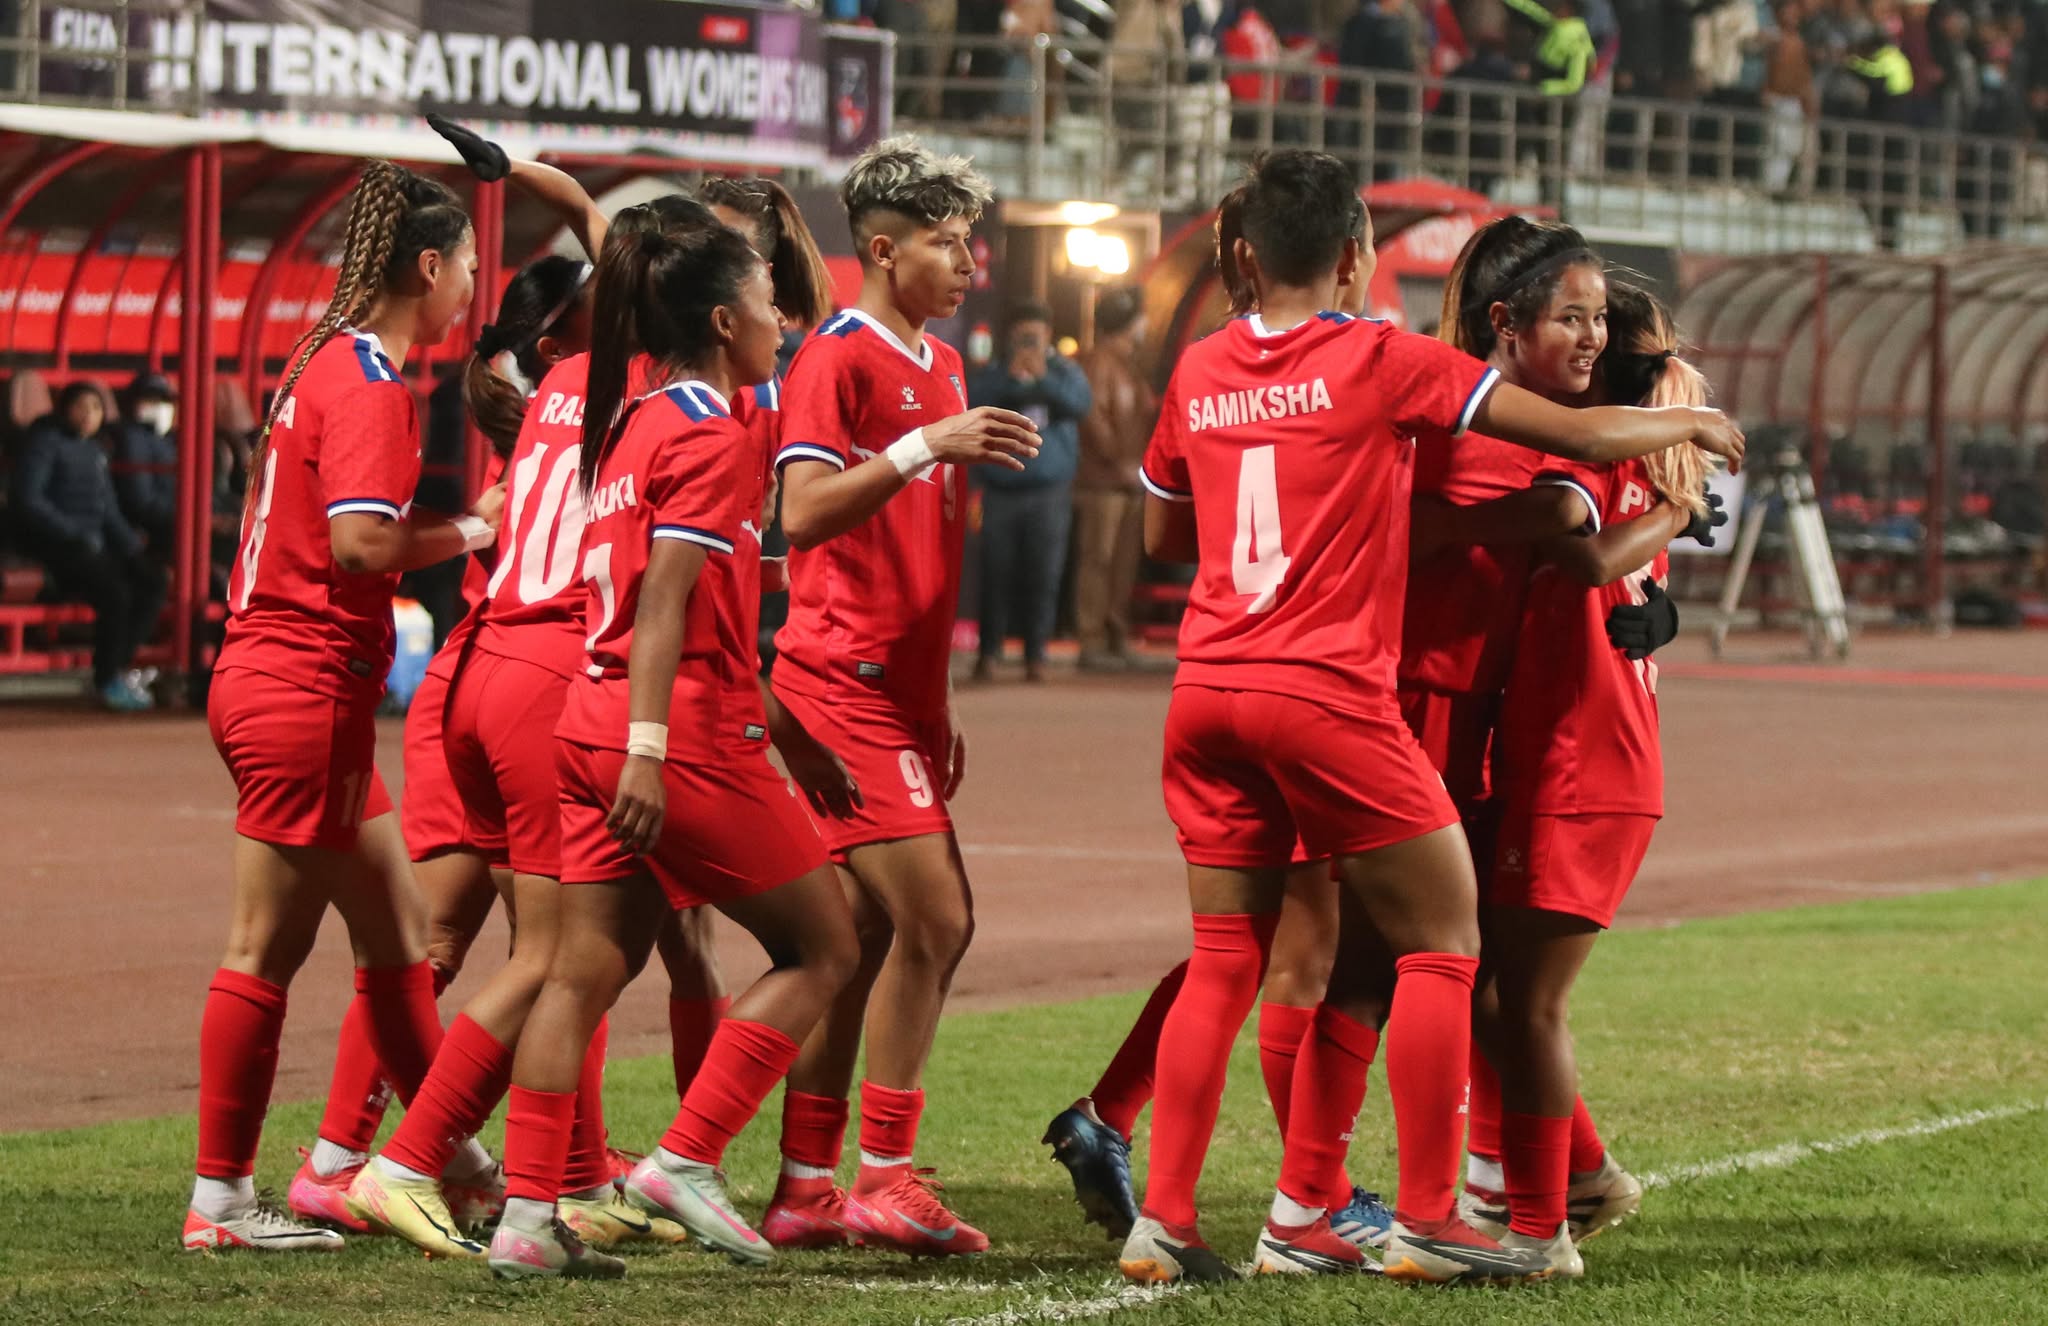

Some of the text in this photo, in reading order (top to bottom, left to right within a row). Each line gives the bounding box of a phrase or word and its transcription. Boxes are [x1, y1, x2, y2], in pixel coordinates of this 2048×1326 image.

[51, 8, 118, 50] FIFA
[1188, 377, 1334, 432] SAMIKSHA
[487, 441, 588, 606] 10
[586, 473, 638, 525] NUKA
[1231, 444, 1292, 615] 4
[898, 749, 934, 808] 9
